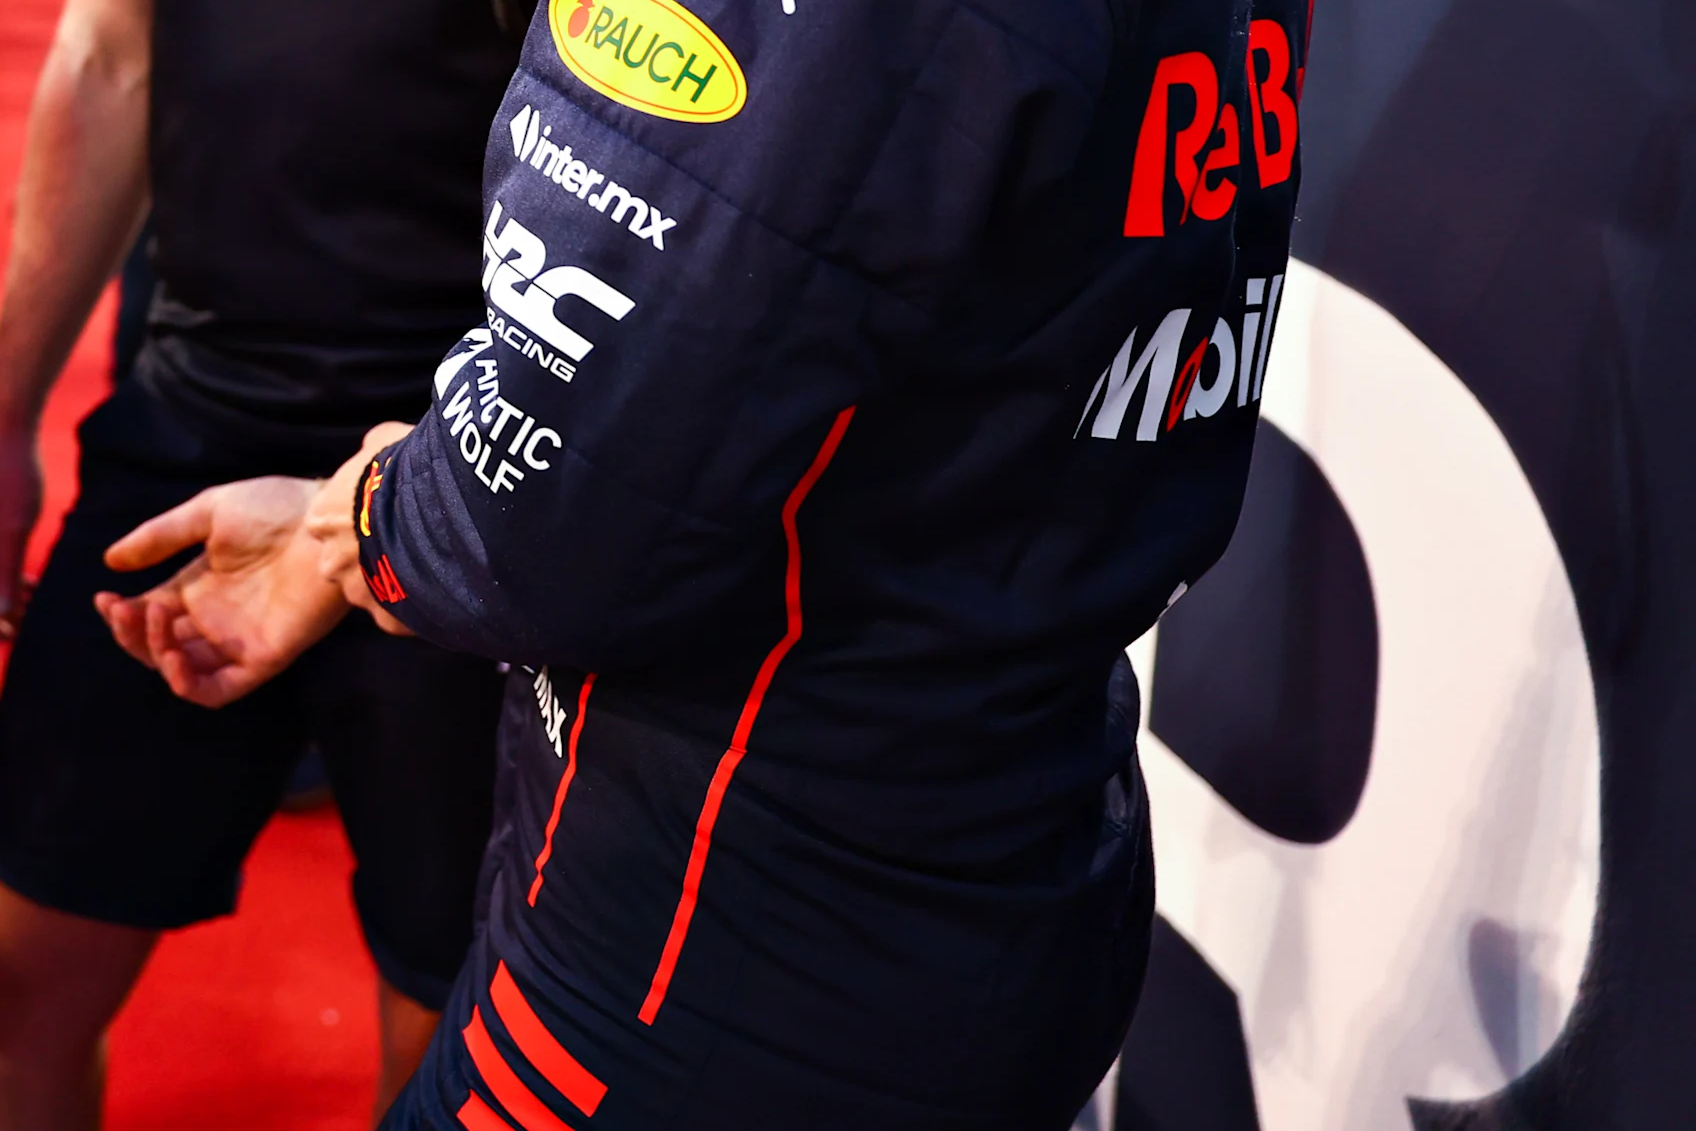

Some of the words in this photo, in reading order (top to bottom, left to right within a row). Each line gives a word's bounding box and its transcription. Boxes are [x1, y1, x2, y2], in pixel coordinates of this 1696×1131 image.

[584, 5, 718, 104] RAUCH
[529, 125, 678, 252] inter.mx
[1122, 51, 1241, 238] Re
[485, 306, 577, 383] RACING
[441, 380, 526, 495] WOLF
